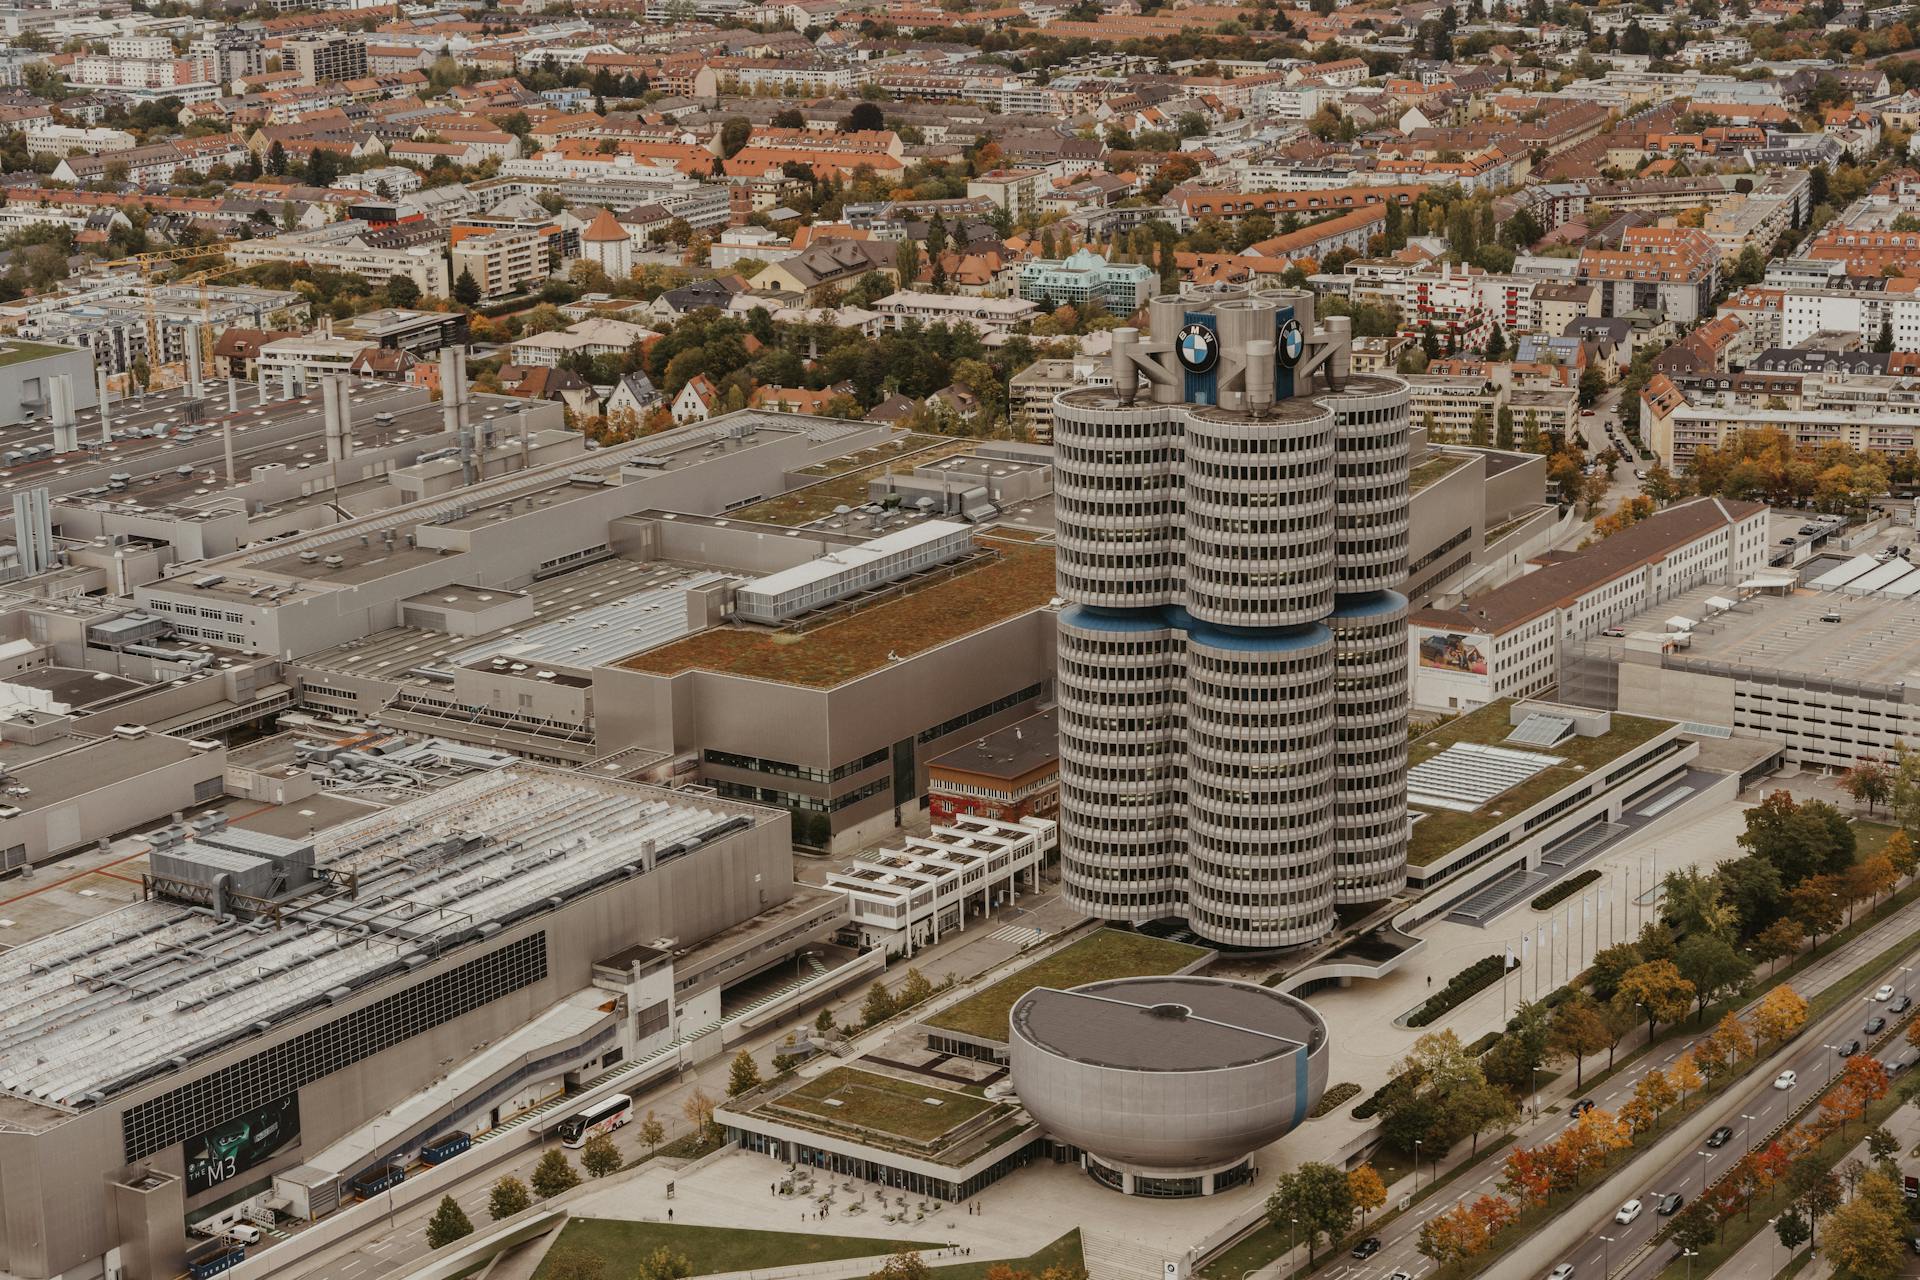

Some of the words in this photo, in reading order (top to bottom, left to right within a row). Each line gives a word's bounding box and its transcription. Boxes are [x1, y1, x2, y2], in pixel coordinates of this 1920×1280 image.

[1178, 326, 1214, 344] BMW
[190, 1169, 205, 1180] THE
[208, 1156, 236, 1187] M3
